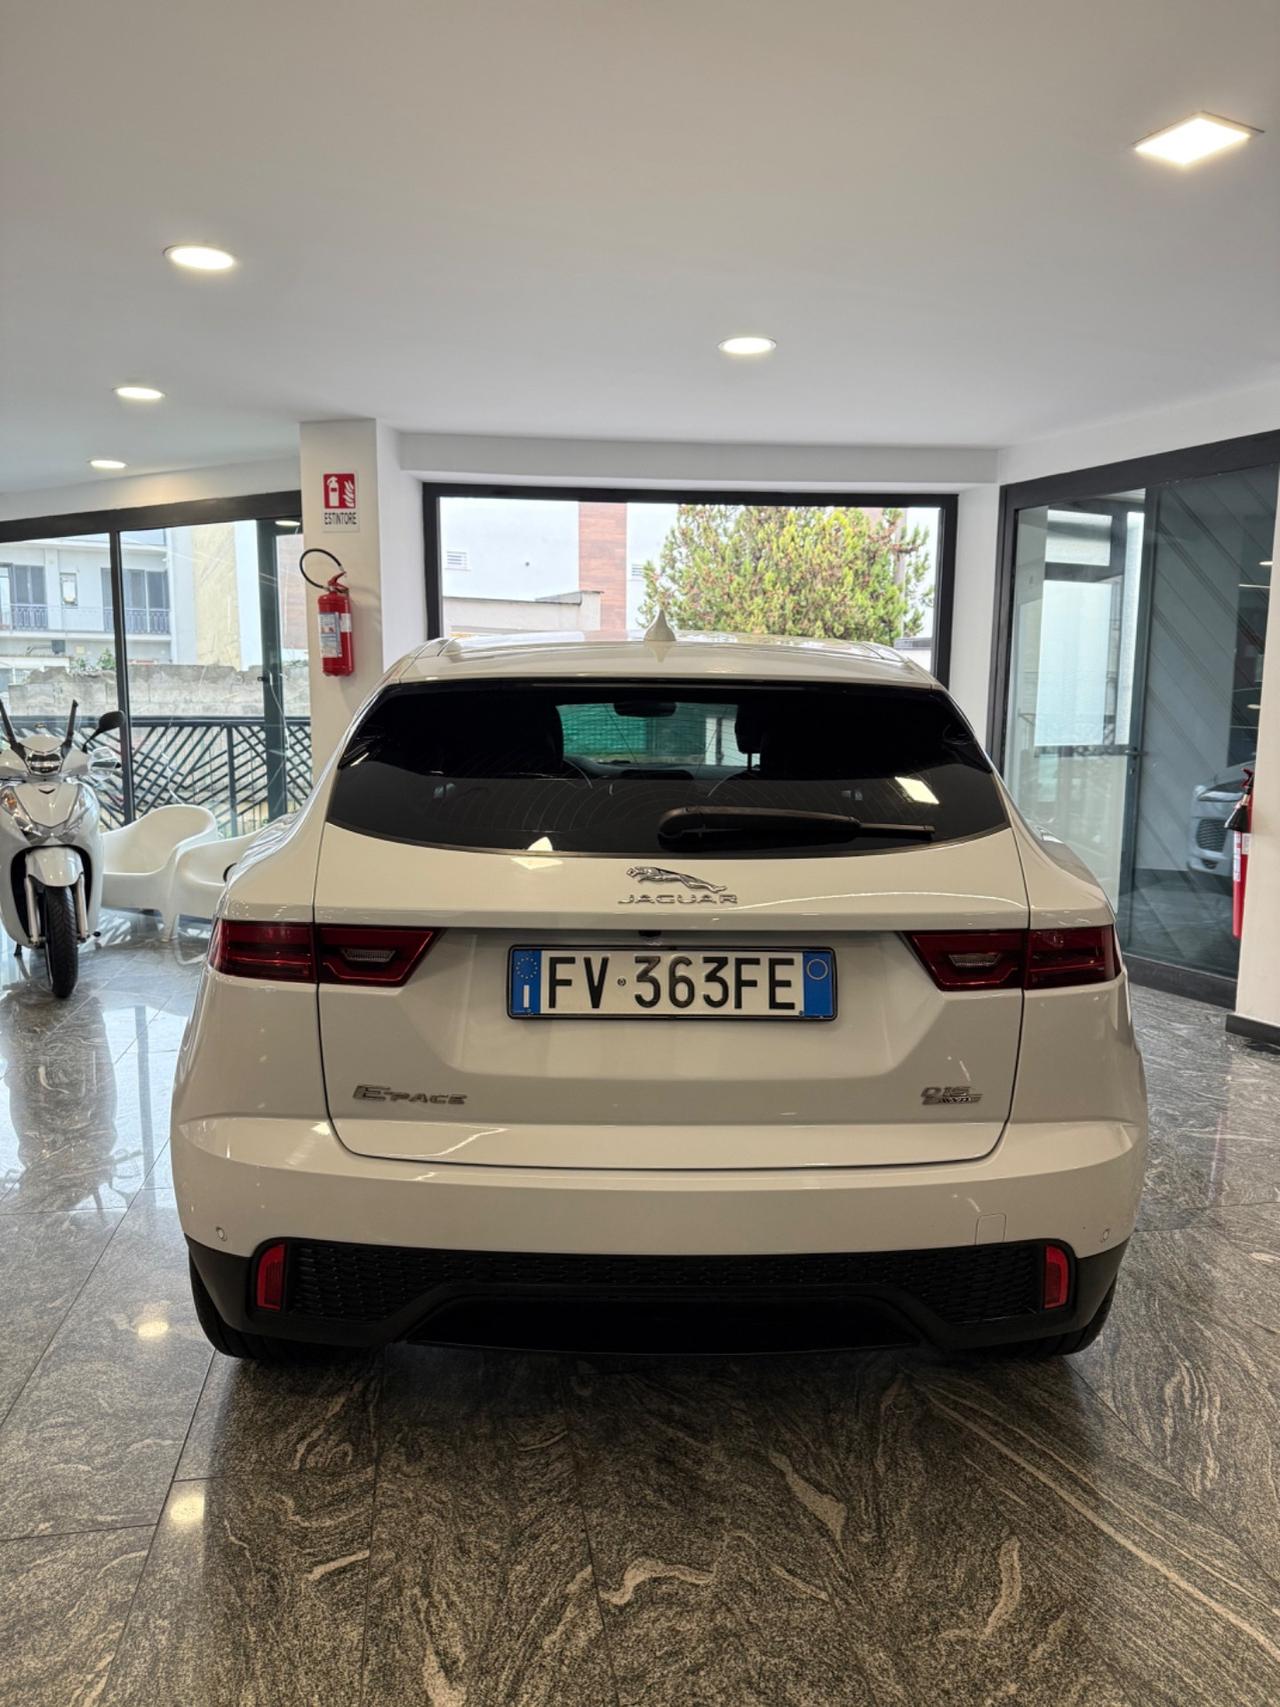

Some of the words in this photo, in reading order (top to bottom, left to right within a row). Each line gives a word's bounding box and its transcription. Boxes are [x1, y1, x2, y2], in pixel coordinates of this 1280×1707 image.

[324, 512, 357, 525] ESTINTORE
[618, 894, 738, 904] JAGUAR
[548, 956, 610, 1009] FV
[634, 955, 796, 1010] 363FE
